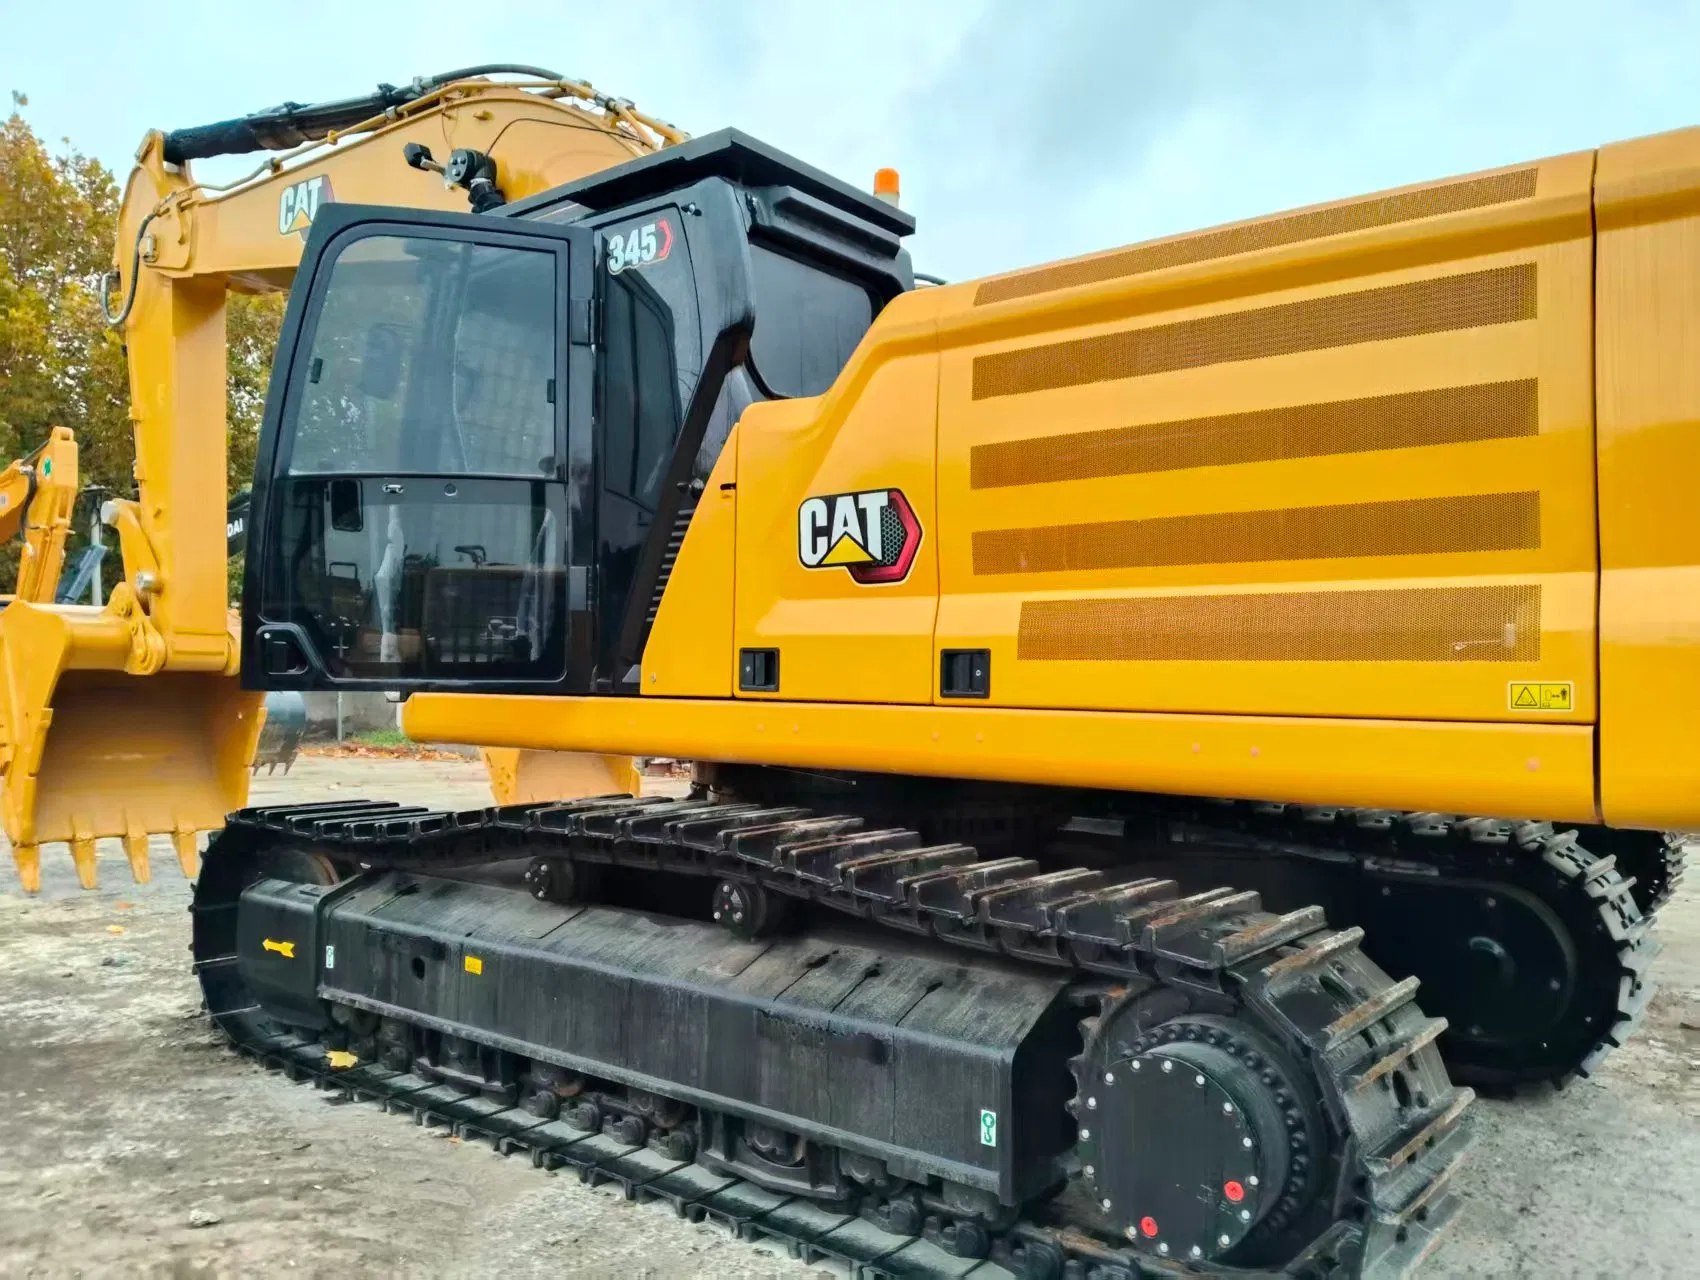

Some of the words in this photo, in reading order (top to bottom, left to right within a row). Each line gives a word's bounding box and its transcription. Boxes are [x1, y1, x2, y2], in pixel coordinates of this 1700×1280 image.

[279, 176, 323, 234] CAT
[609, 223, 657, 272] 345
[799, 490, 889, 566] CAT
